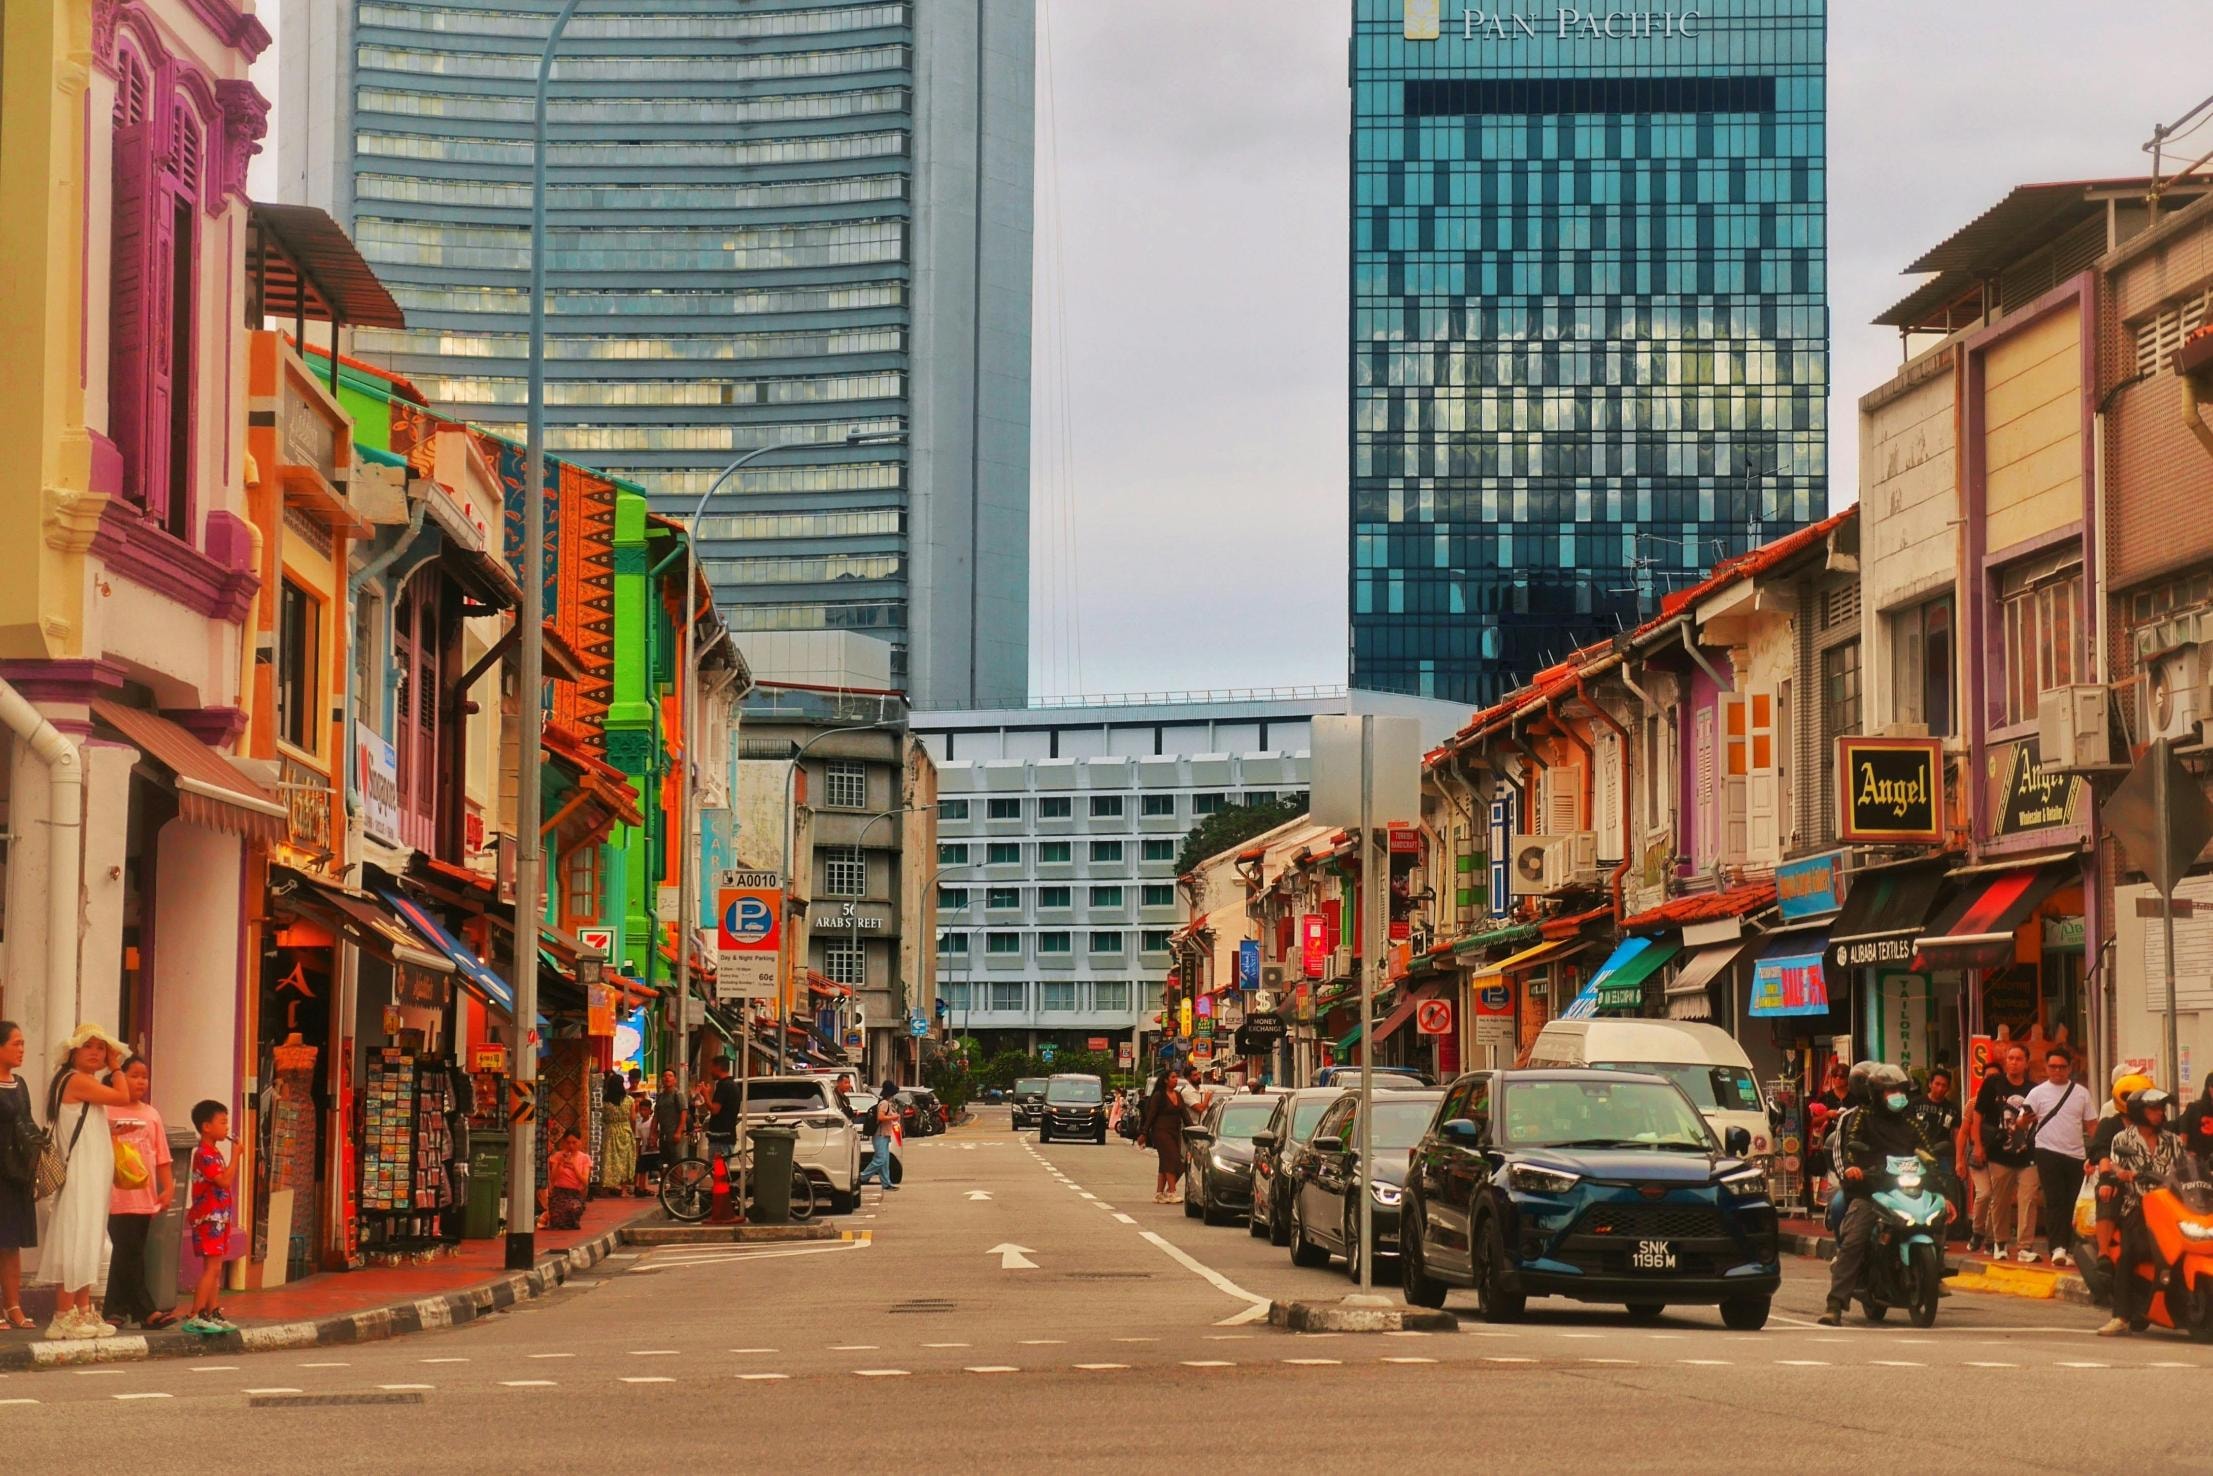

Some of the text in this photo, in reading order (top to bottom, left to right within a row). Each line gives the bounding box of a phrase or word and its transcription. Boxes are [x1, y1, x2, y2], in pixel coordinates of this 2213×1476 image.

[1463, 7, 1702, 40] PAN PACIFIC
[1857, 761, 1928, 818] Angel
[736, 874, 777, 888] A0010
[815, 917, 844, 928] ARAB
[1850, 944, 1877, 964] ALIBABA
[1878, 940, 1909, 961] TEXTILES
[1248, 1025, 1282, 1033] EXCHANGE
[1639, 1240, 1669, 1255] SNK
[1632, 1253, 1676, 1268] 1196M
